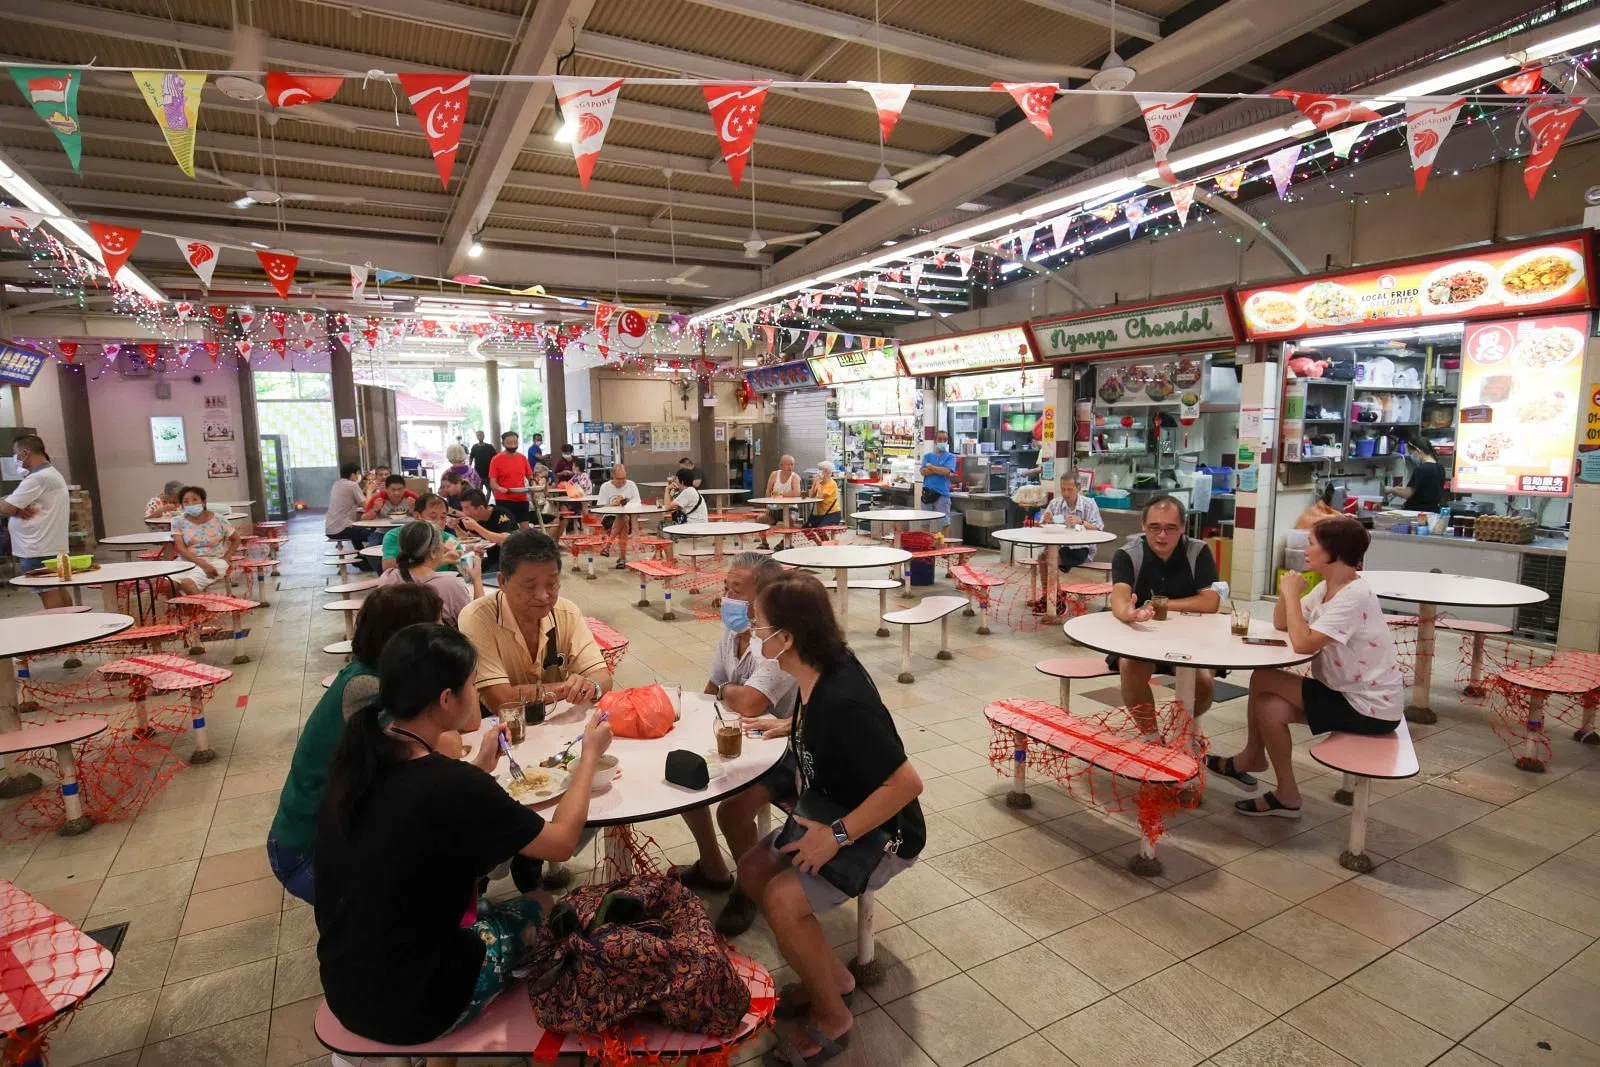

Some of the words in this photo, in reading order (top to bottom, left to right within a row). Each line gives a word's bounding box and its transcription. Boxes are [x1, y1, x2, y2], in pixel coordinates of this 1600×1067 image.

[1361, 293, 1388, 302] LOCAL
[1391, 288, 1419, 298] FRIED
[1051, 328, 1118, 352] Nyonya
[1125, 307, 1213, 339] Chendol
